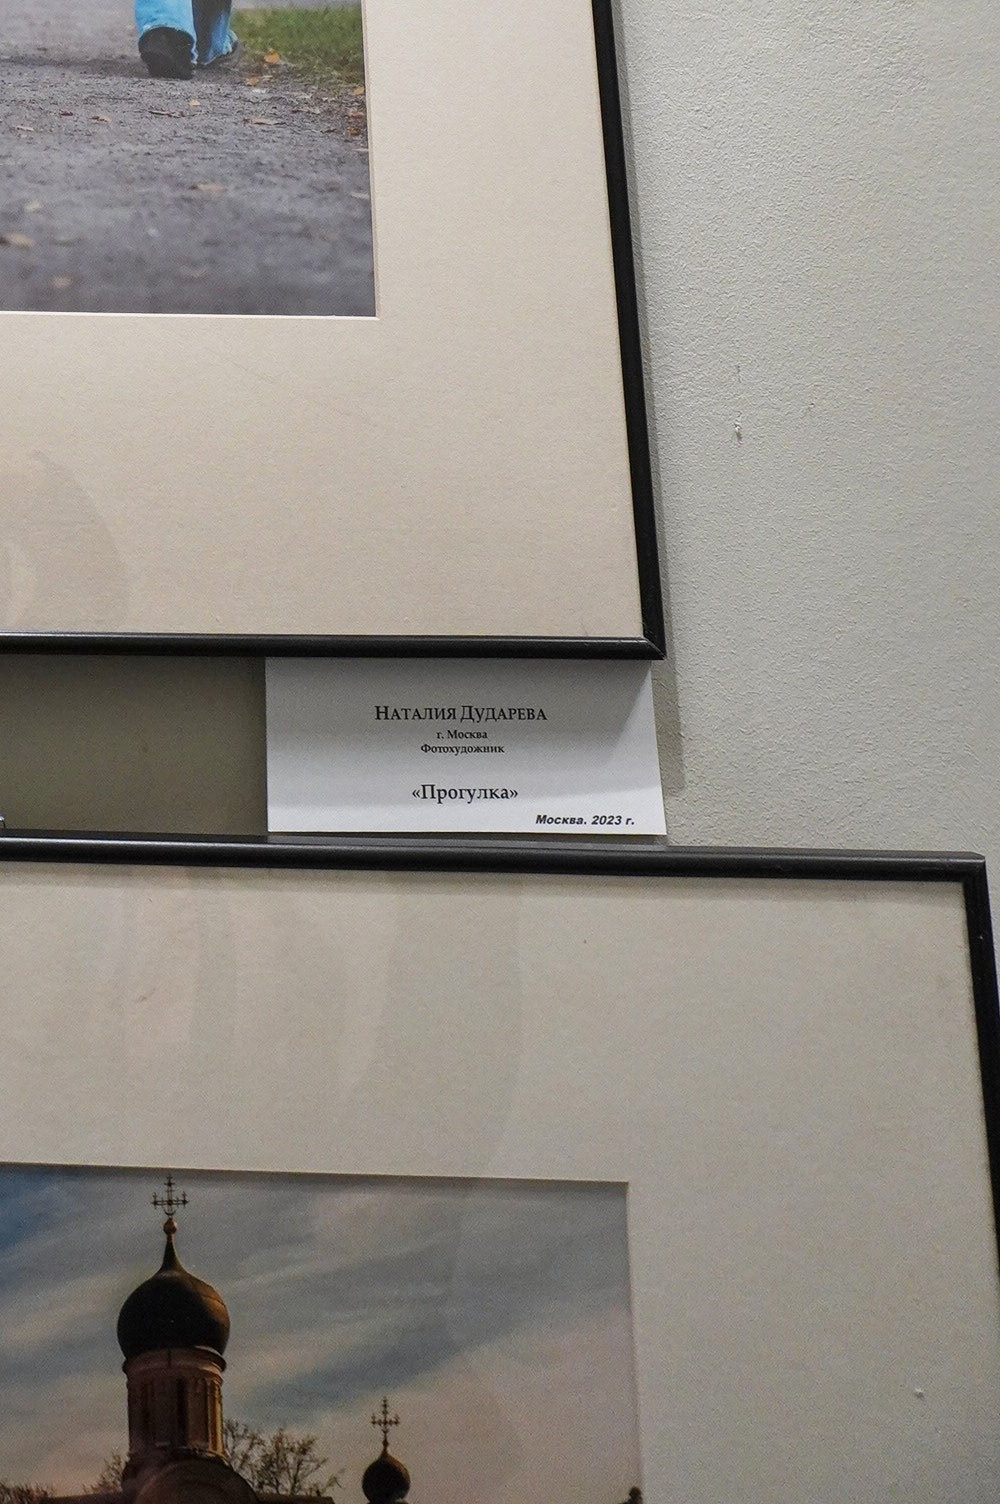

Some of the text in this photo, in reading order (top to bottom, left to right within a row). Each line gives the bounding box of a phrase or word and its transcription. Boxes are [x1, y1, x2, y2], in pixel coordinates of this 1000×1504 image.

[374, 704, 548, 723] НАТАЛИЯ ДУДАРЕВА
[436, 729, 488, 740] г. Москва
[420, 743, 505, 755] Фотохудожник
[411, 784, 519, 805] «Прогулка»
[535, 814, 635, 826] Москва. 2023 г.
